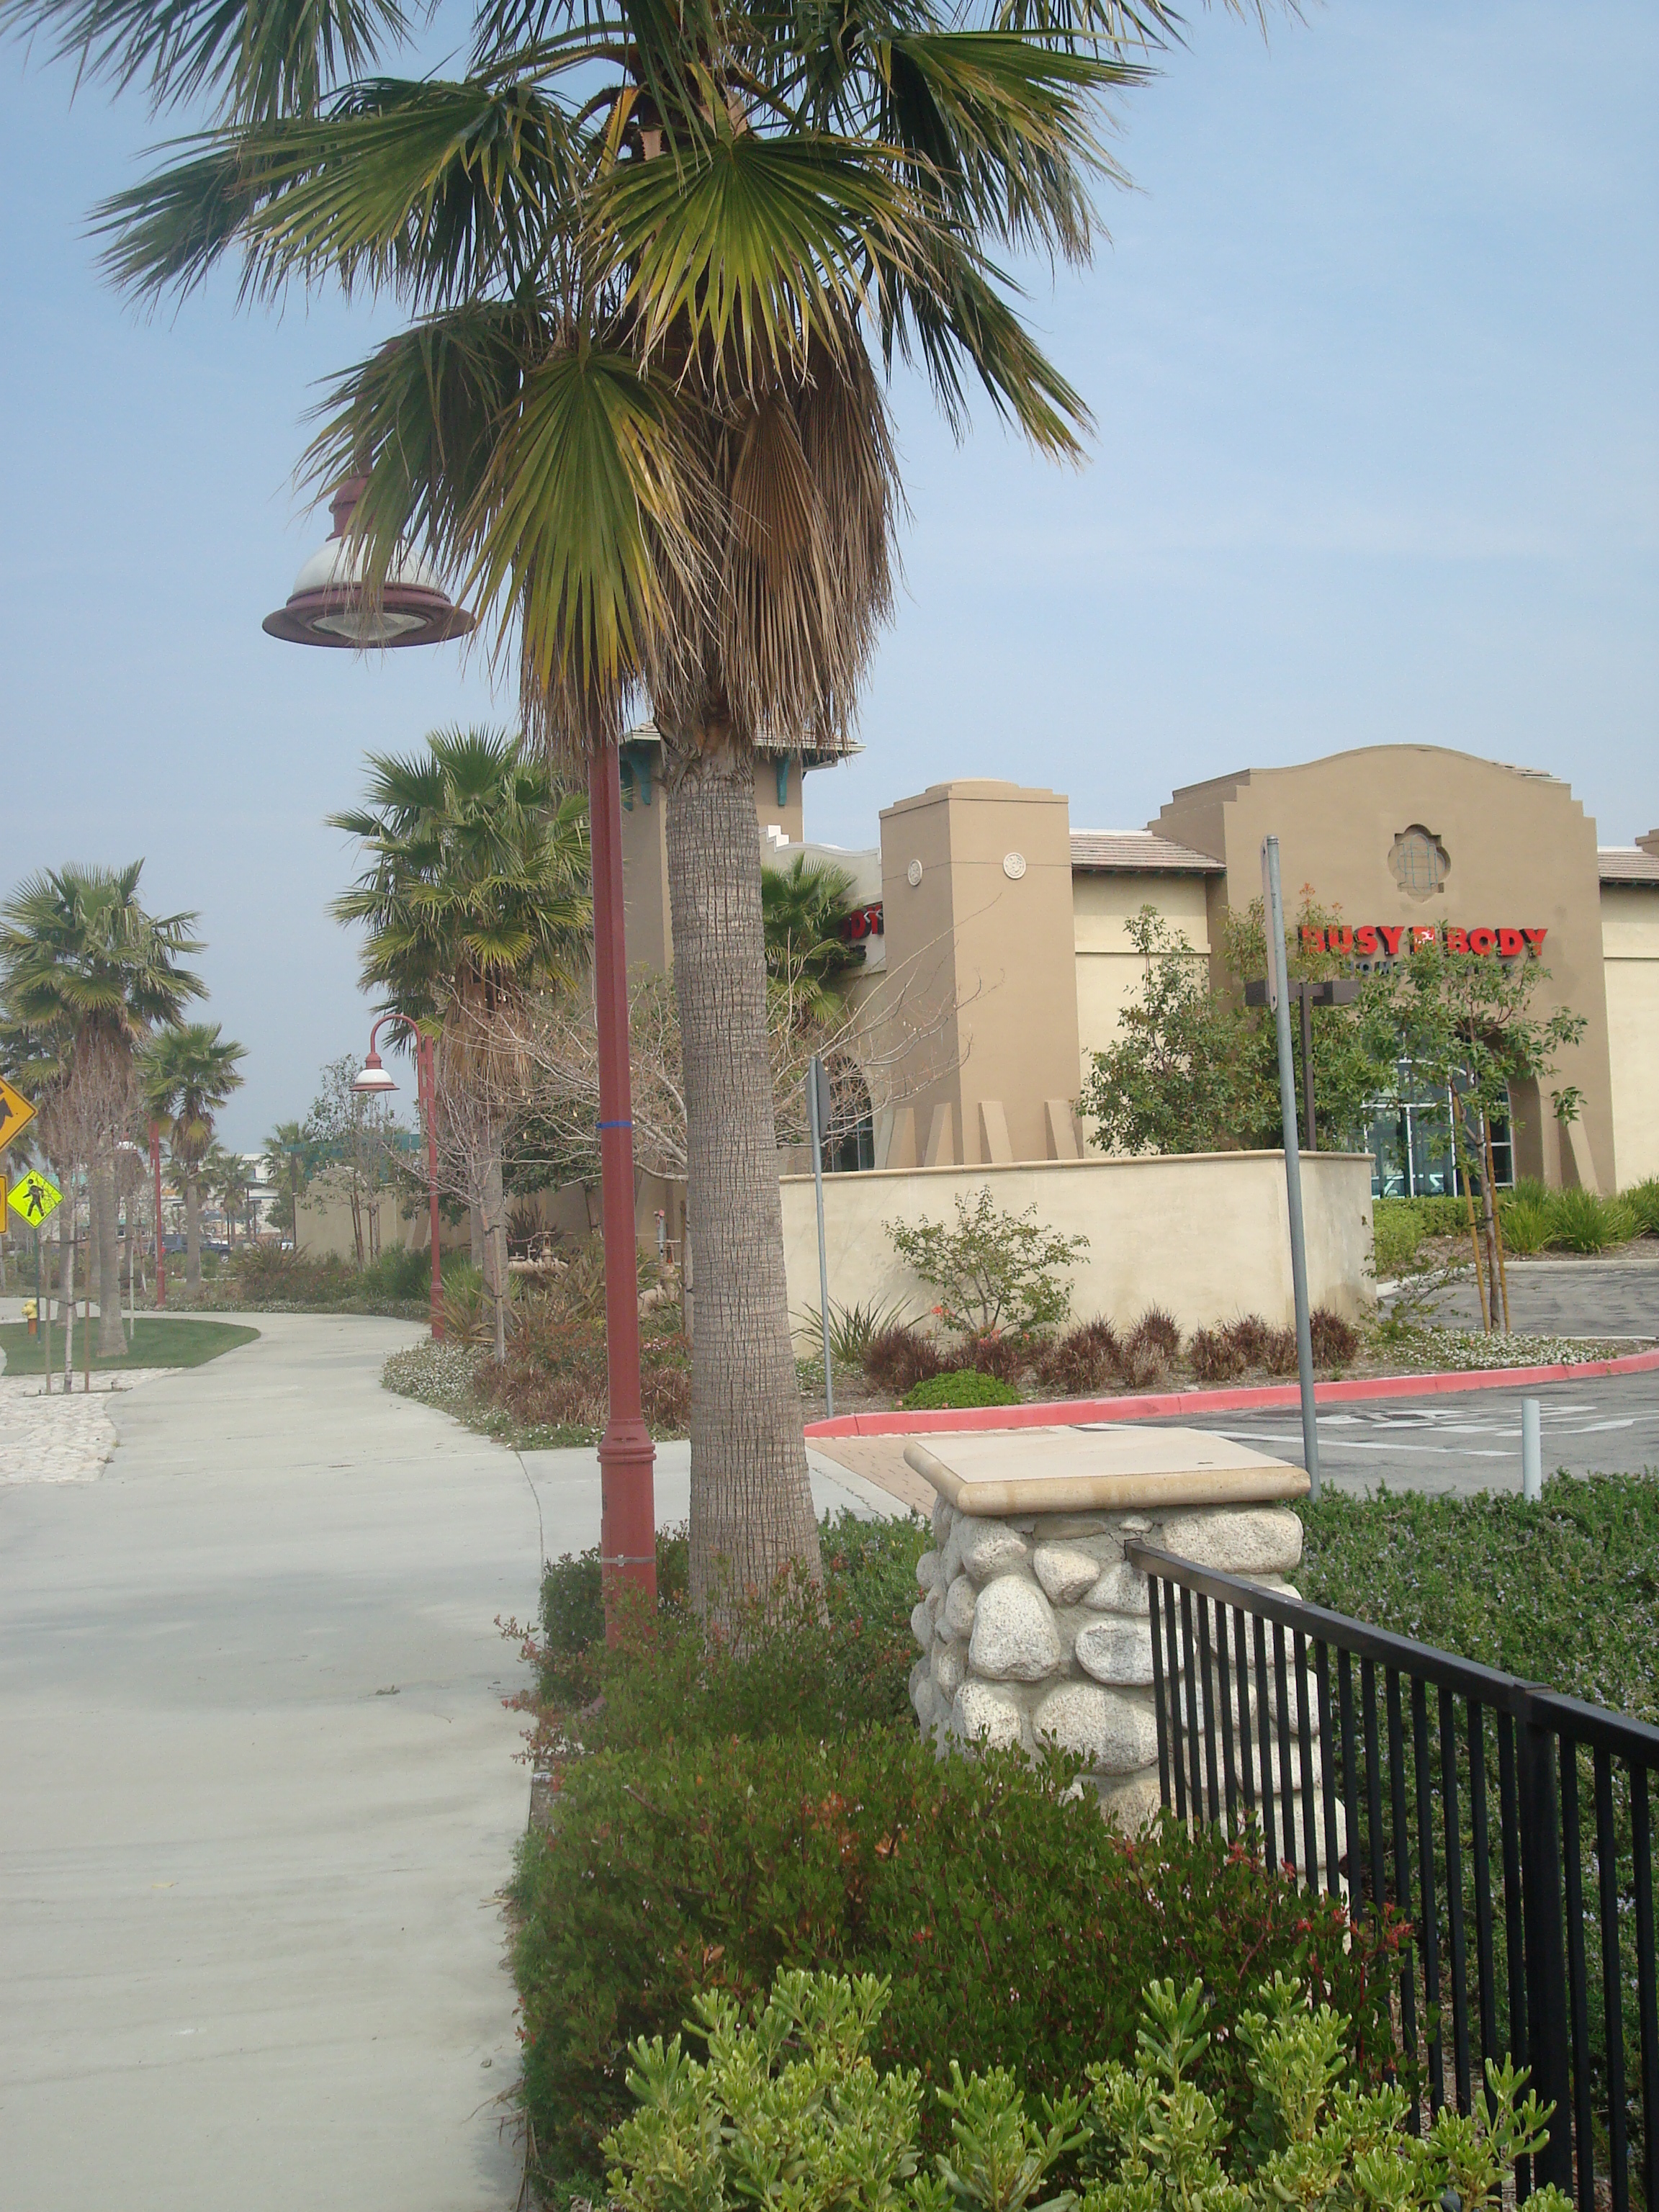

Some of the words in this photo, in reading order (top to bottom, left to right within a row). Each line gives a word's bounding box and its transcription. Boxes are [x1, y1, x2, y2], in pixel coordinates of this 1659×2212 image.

[840, 904, 884, 939] DY
[1298, 925, 1404, 956] BUSY
[1443, 927, 1547, 957] BODY
